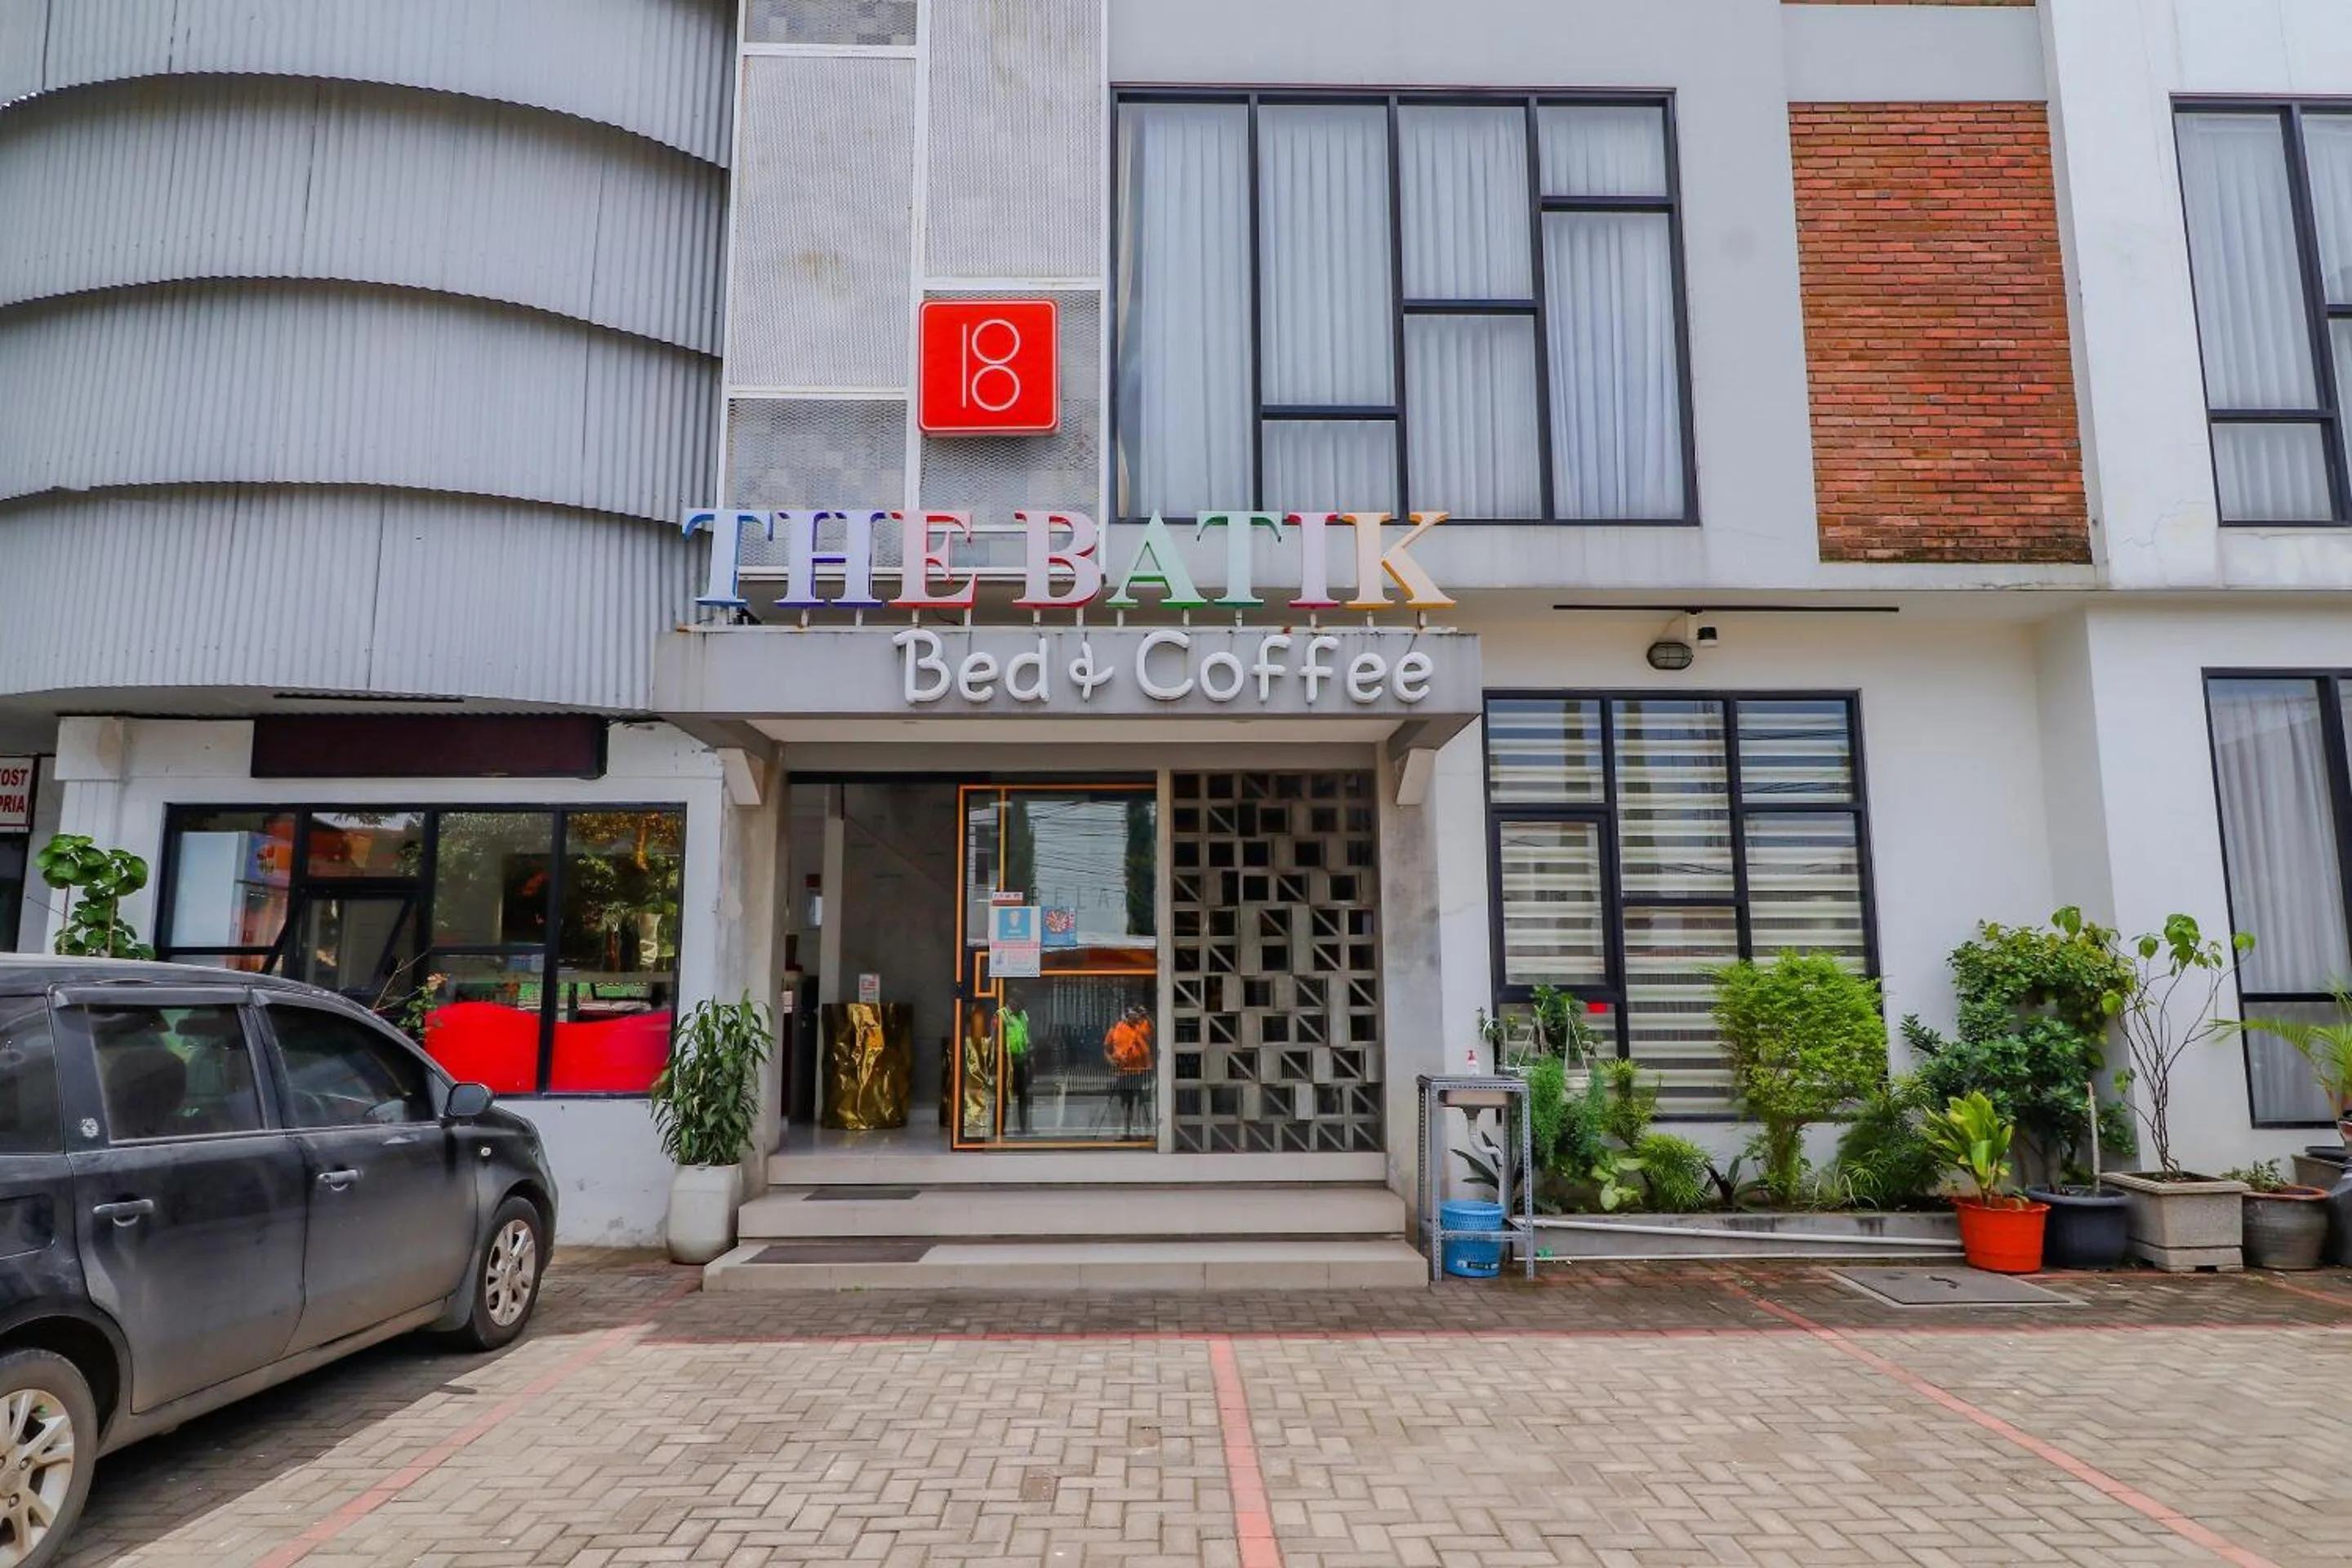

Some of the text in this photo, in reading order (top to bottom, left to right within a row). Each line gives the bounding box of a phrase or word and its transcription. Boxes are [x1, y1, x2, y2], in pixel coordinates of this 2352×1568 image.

[961, 318, 1020, 412] 18
[681, 508, 1457, 610] THE BATIK
[893, 629, 1435, 704] Bed & Coffee
[0, 768, 29, 786] OST
